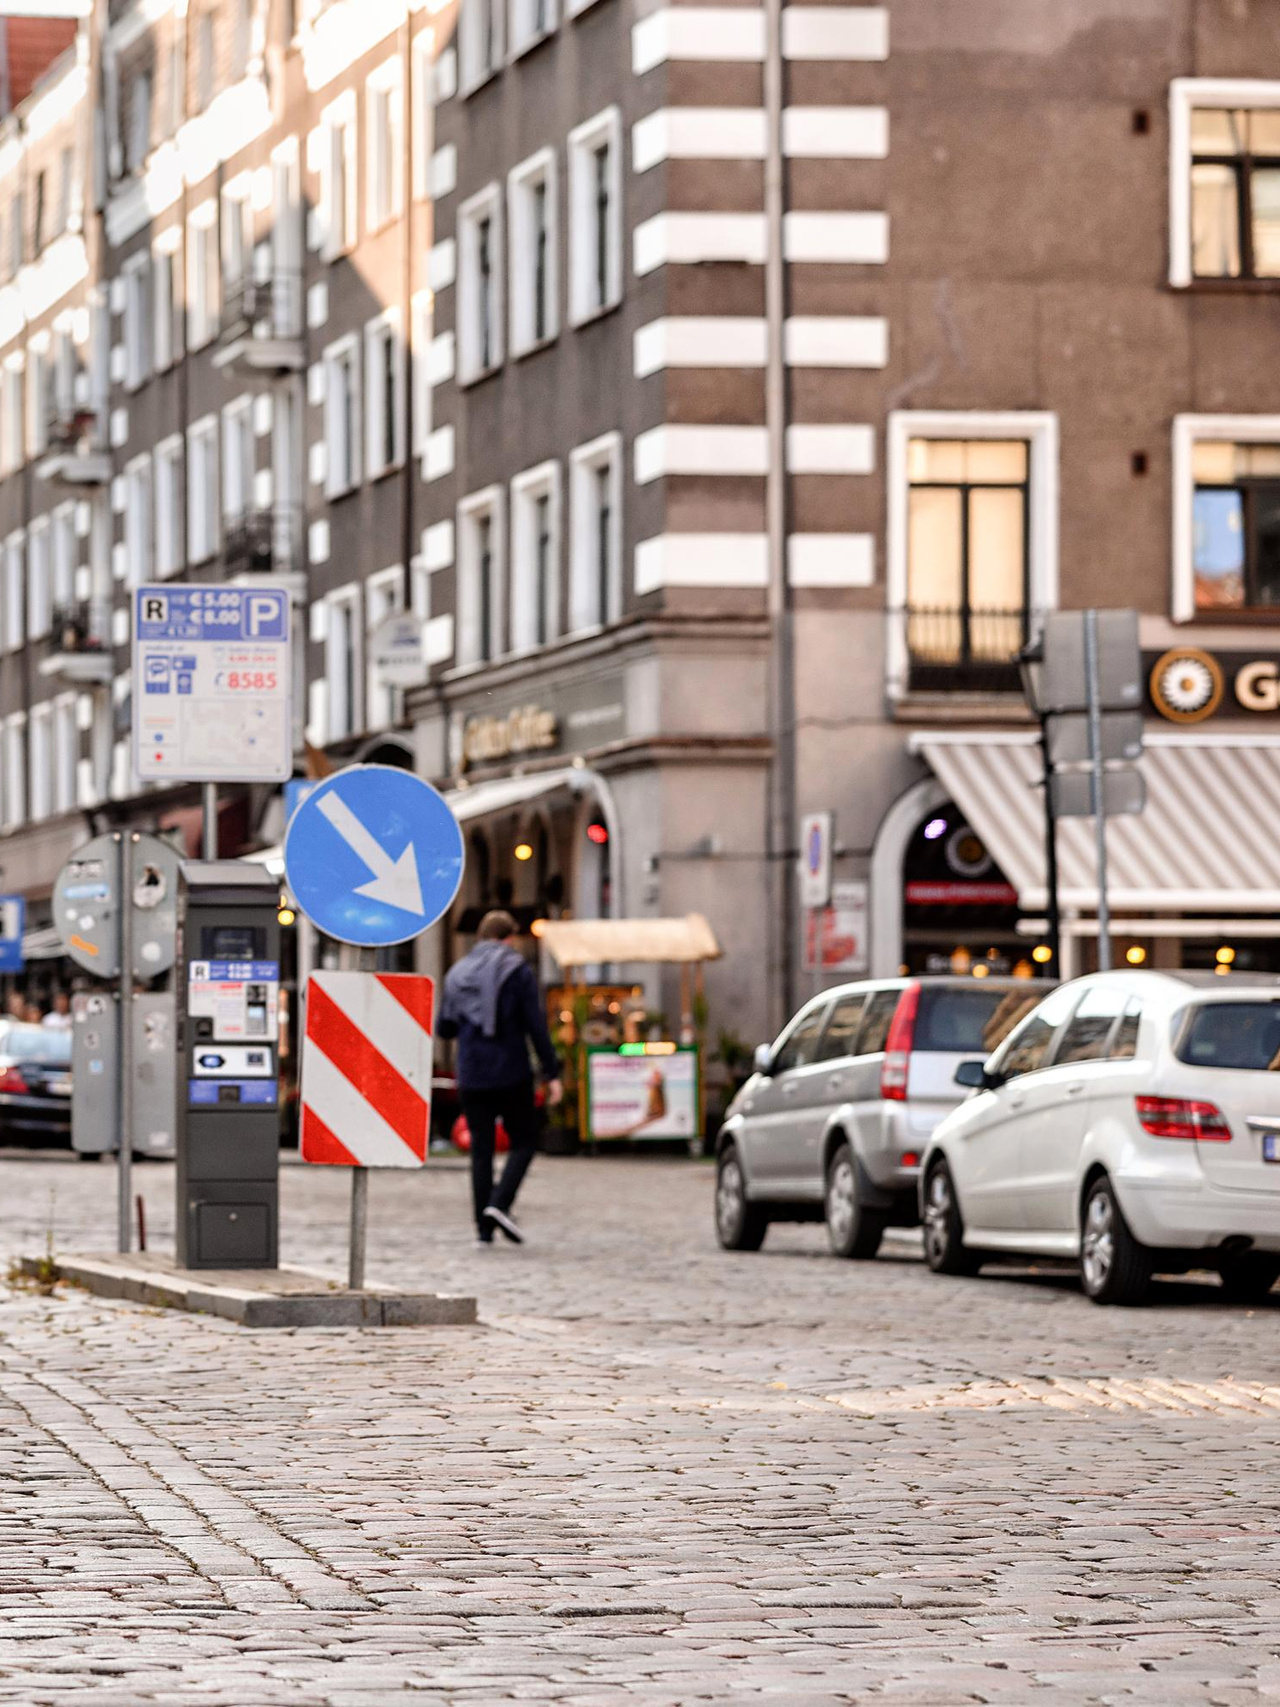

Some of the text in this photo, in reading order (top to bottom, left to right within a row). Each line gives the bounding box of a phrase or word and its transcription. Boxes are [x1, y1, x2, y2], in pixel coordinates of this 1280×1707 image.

[147, 599, 163, 619] R
[249, 597, 280, 635] P
[228, 672, 277, 690] 8585
[1235, 661, 1280, 712] G
